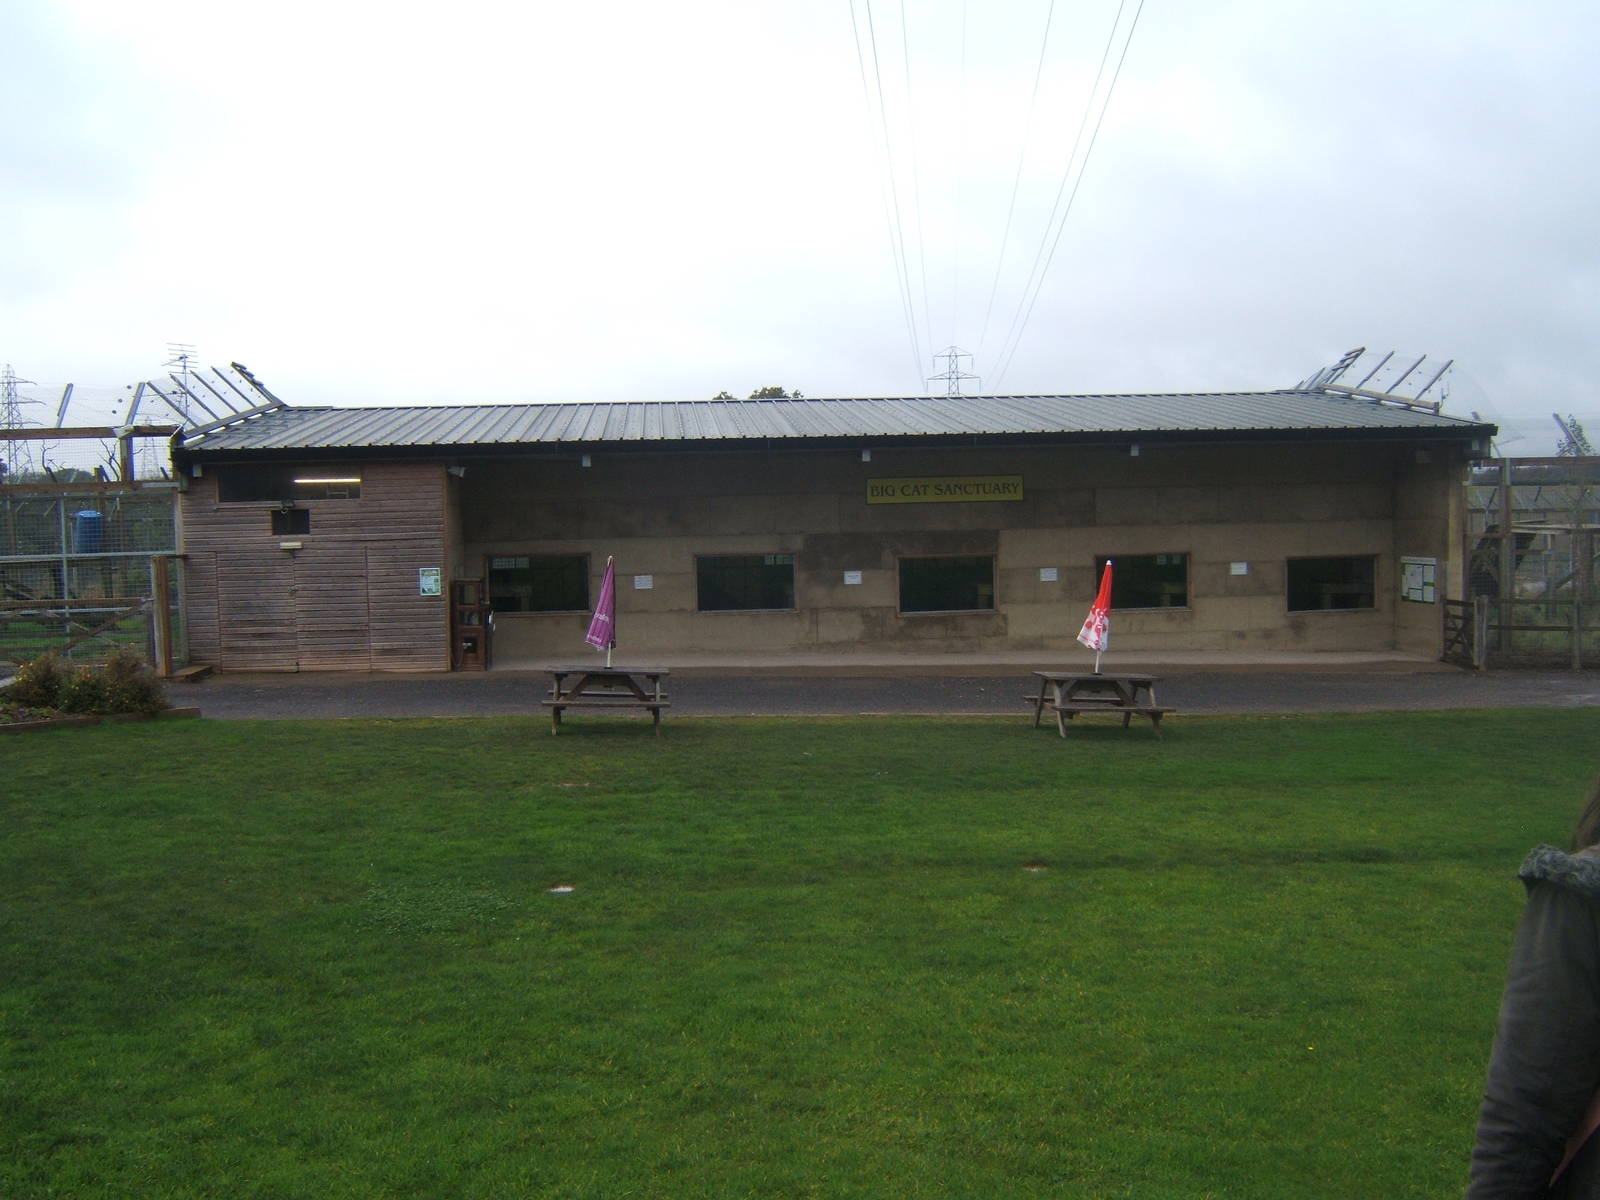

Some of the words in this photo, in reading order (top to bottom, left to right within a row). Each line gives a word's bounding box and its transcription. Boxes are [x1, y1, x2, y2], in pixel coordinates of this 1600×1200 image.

[870, 485, 896, 497] BIG
[901, 484, 930, 497] CAT
[934, 483, 1020, 496] SANCTUARY
